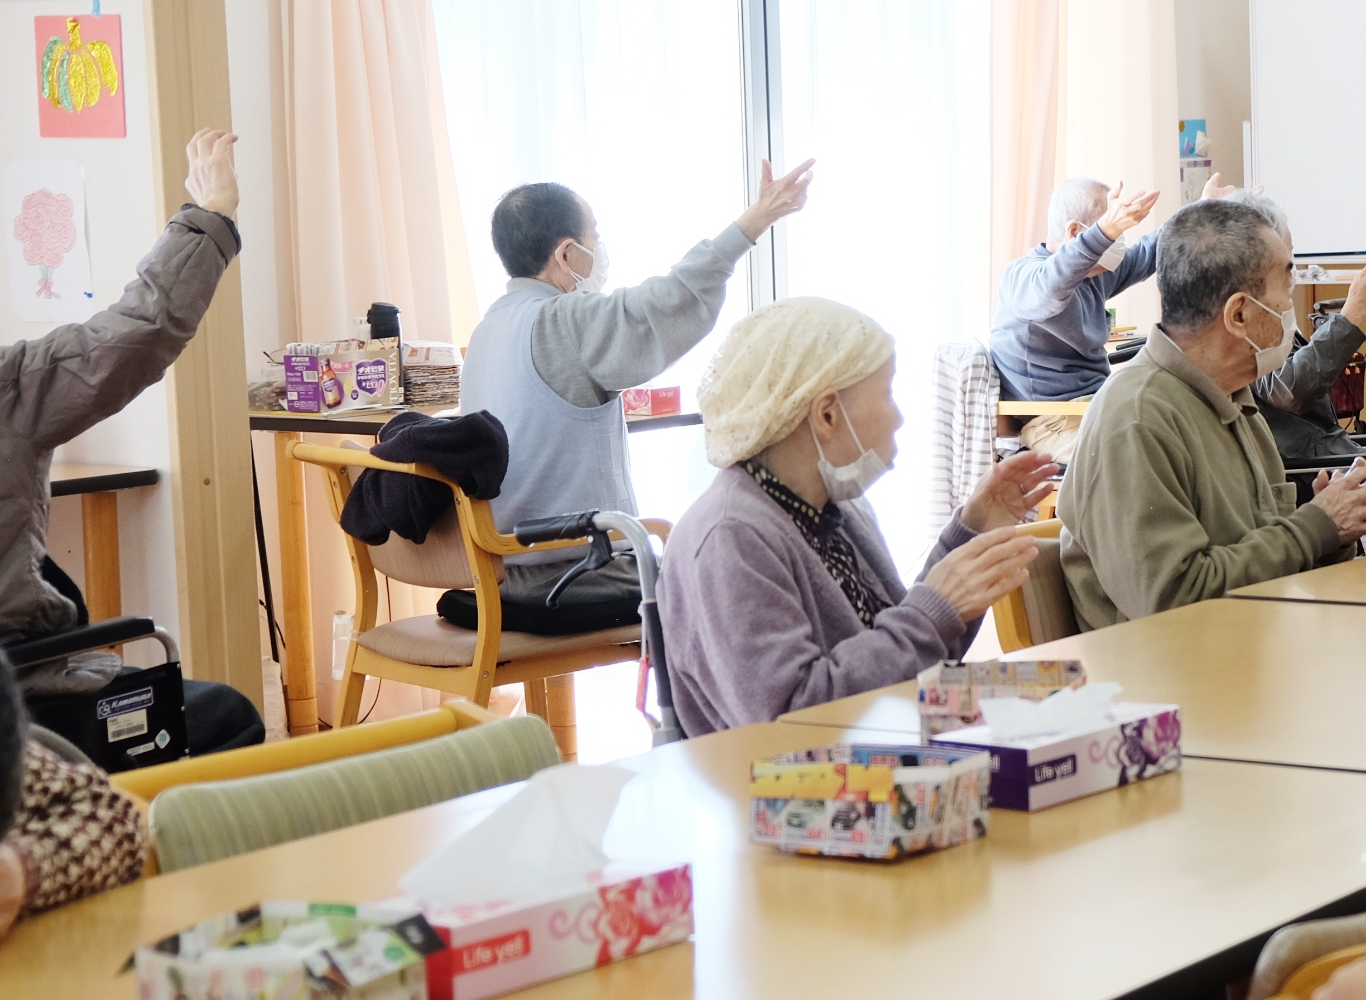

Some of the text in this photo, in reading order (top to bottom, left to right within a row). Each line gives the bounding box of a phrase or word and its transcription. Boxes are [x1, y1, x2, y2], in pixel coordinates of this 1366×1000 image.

[1034, 757, 1074, 783] Life yell
[462, 935, 524, 970] Life yell
